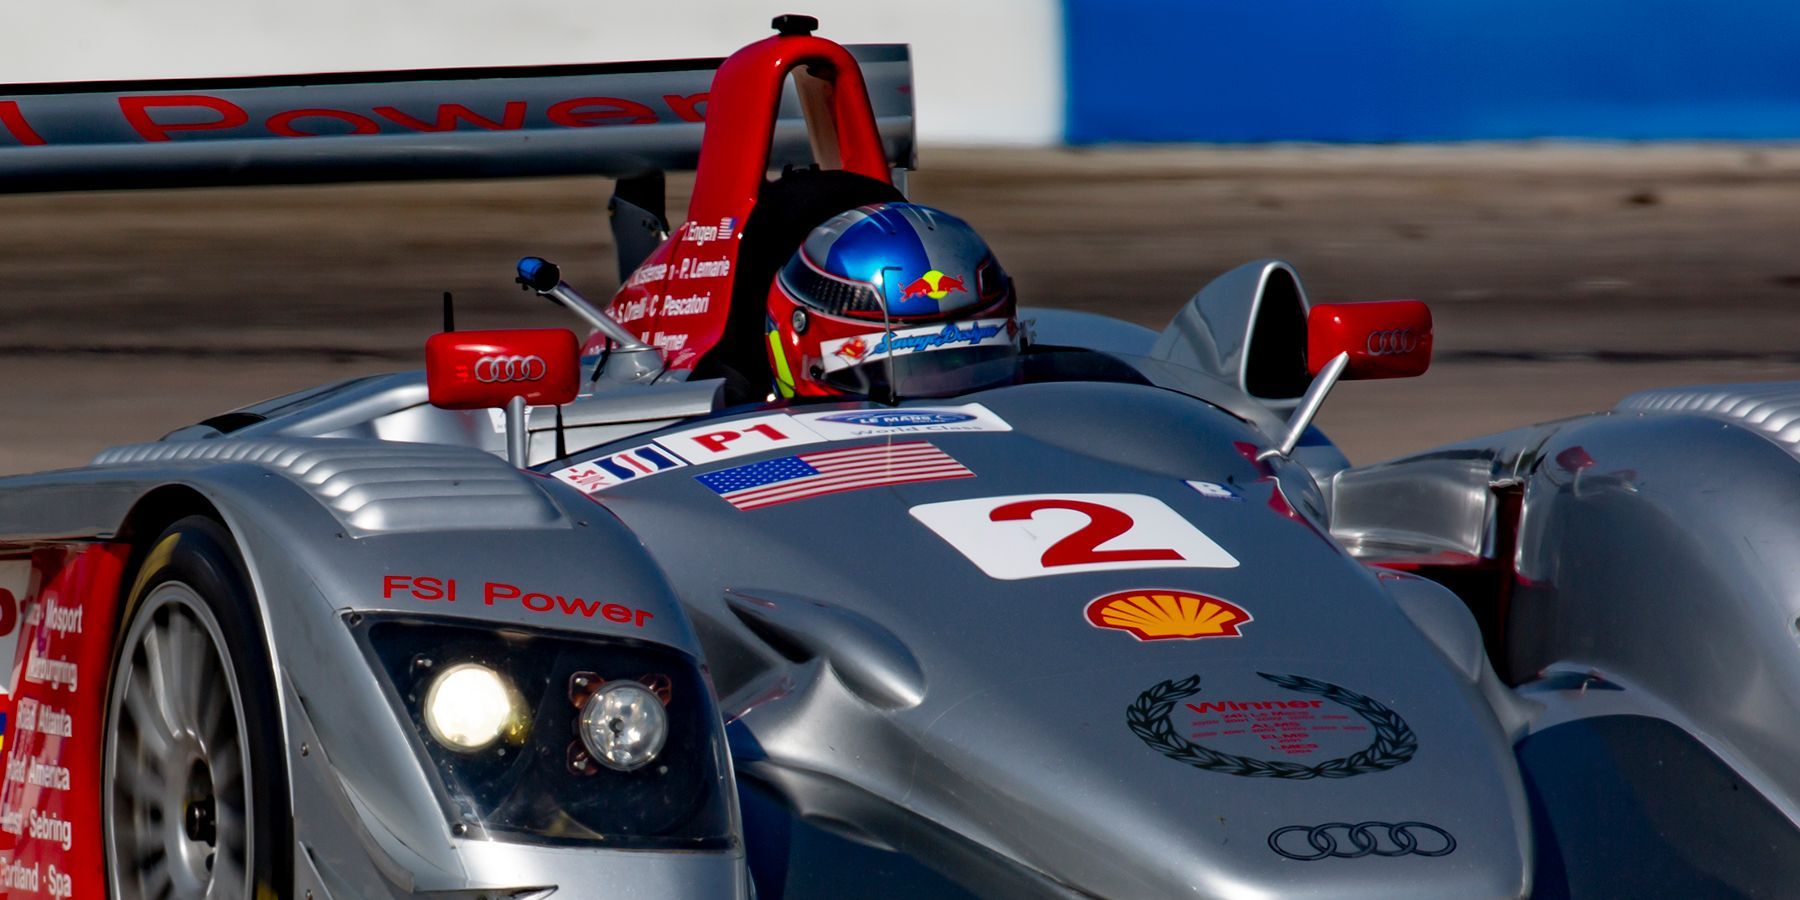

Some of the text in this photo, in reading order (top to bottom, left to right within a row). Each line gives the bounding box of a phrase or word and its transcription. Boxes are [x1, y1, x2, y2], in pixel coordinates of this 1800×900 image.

[691, 421, 788, 453] P1
[850, 426, 917, 436] World
[988, 499, 1187, 568] 2
[383, 575, 654, 628] FSI Power
[1185, 698, 1324, 714] Winner
[27, 755, 71, 791] America
[29, 807, 72, 851] Sebring
[0, 857, 72, 899] Portland Spa
